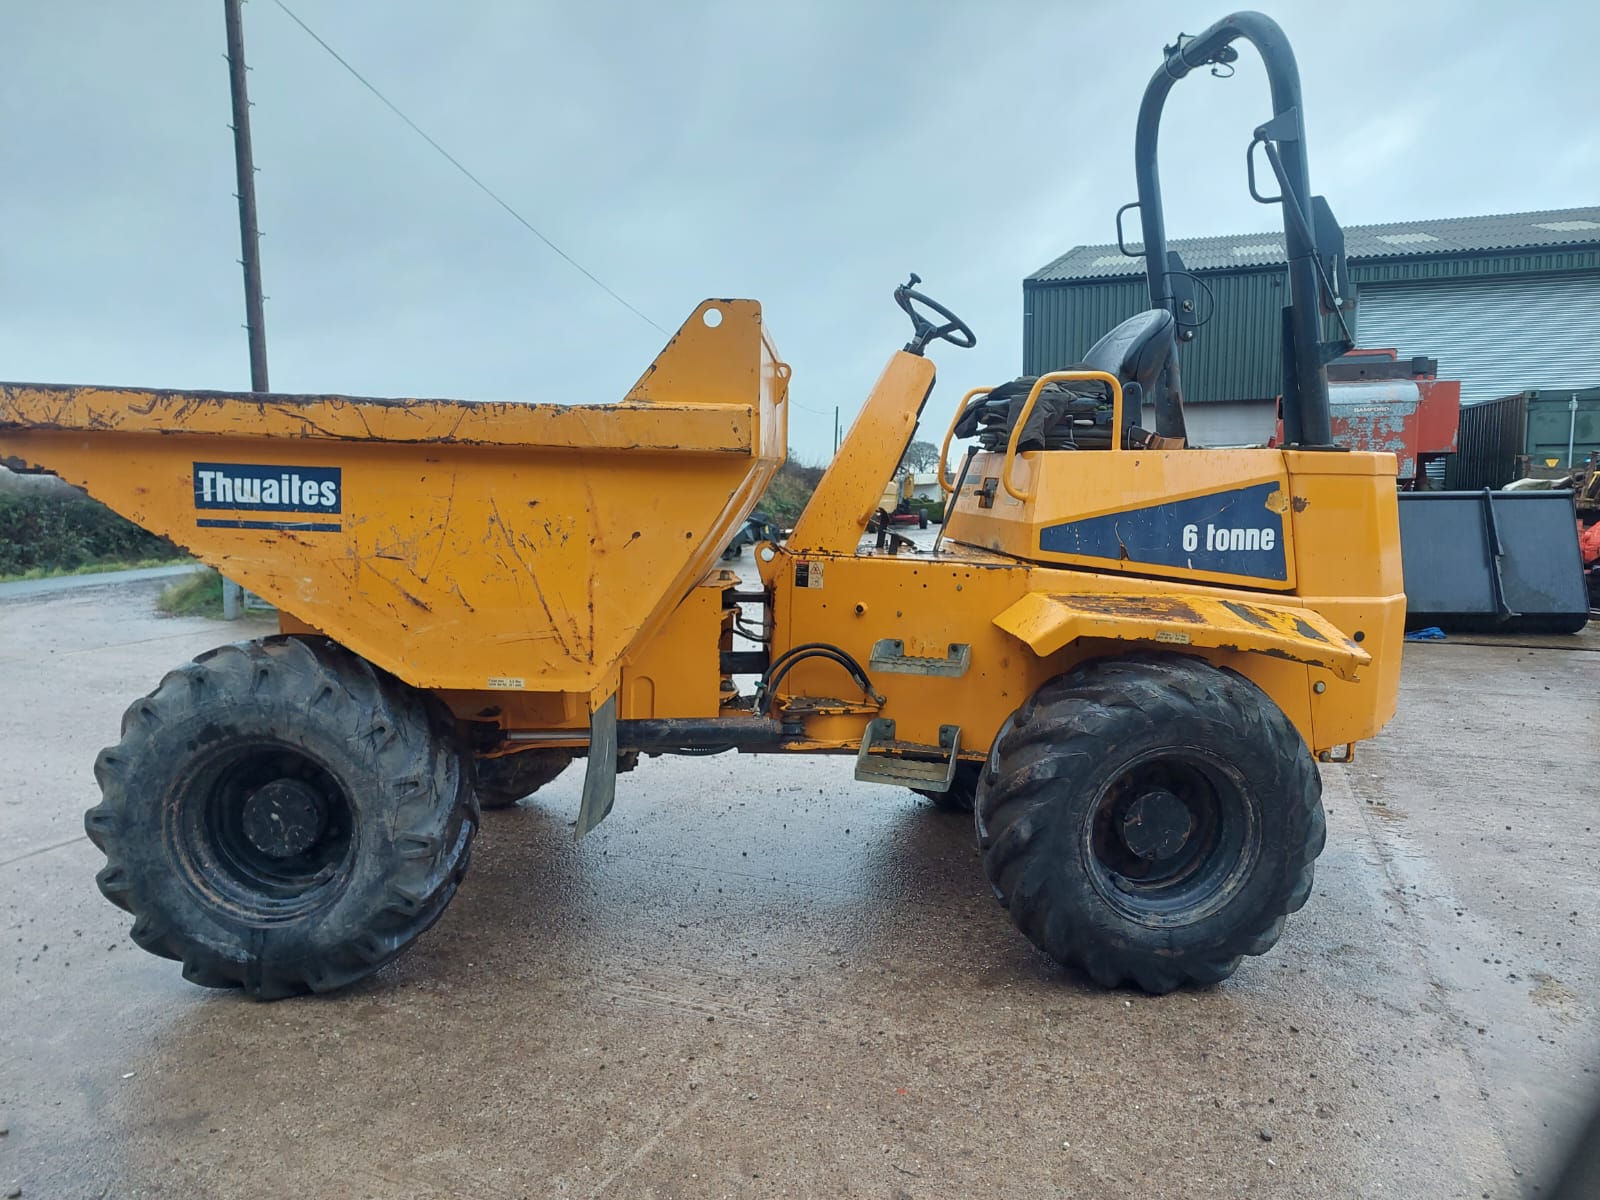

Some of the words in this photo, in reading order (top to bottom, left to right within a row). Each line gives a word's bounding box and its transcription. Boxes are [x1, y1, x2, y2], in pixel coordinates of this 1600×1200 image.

[198, 470, 337, 506] Thwaites
[1182, 524, 1198, 552] 6
[1206, 523, 1275, 551] tonne
